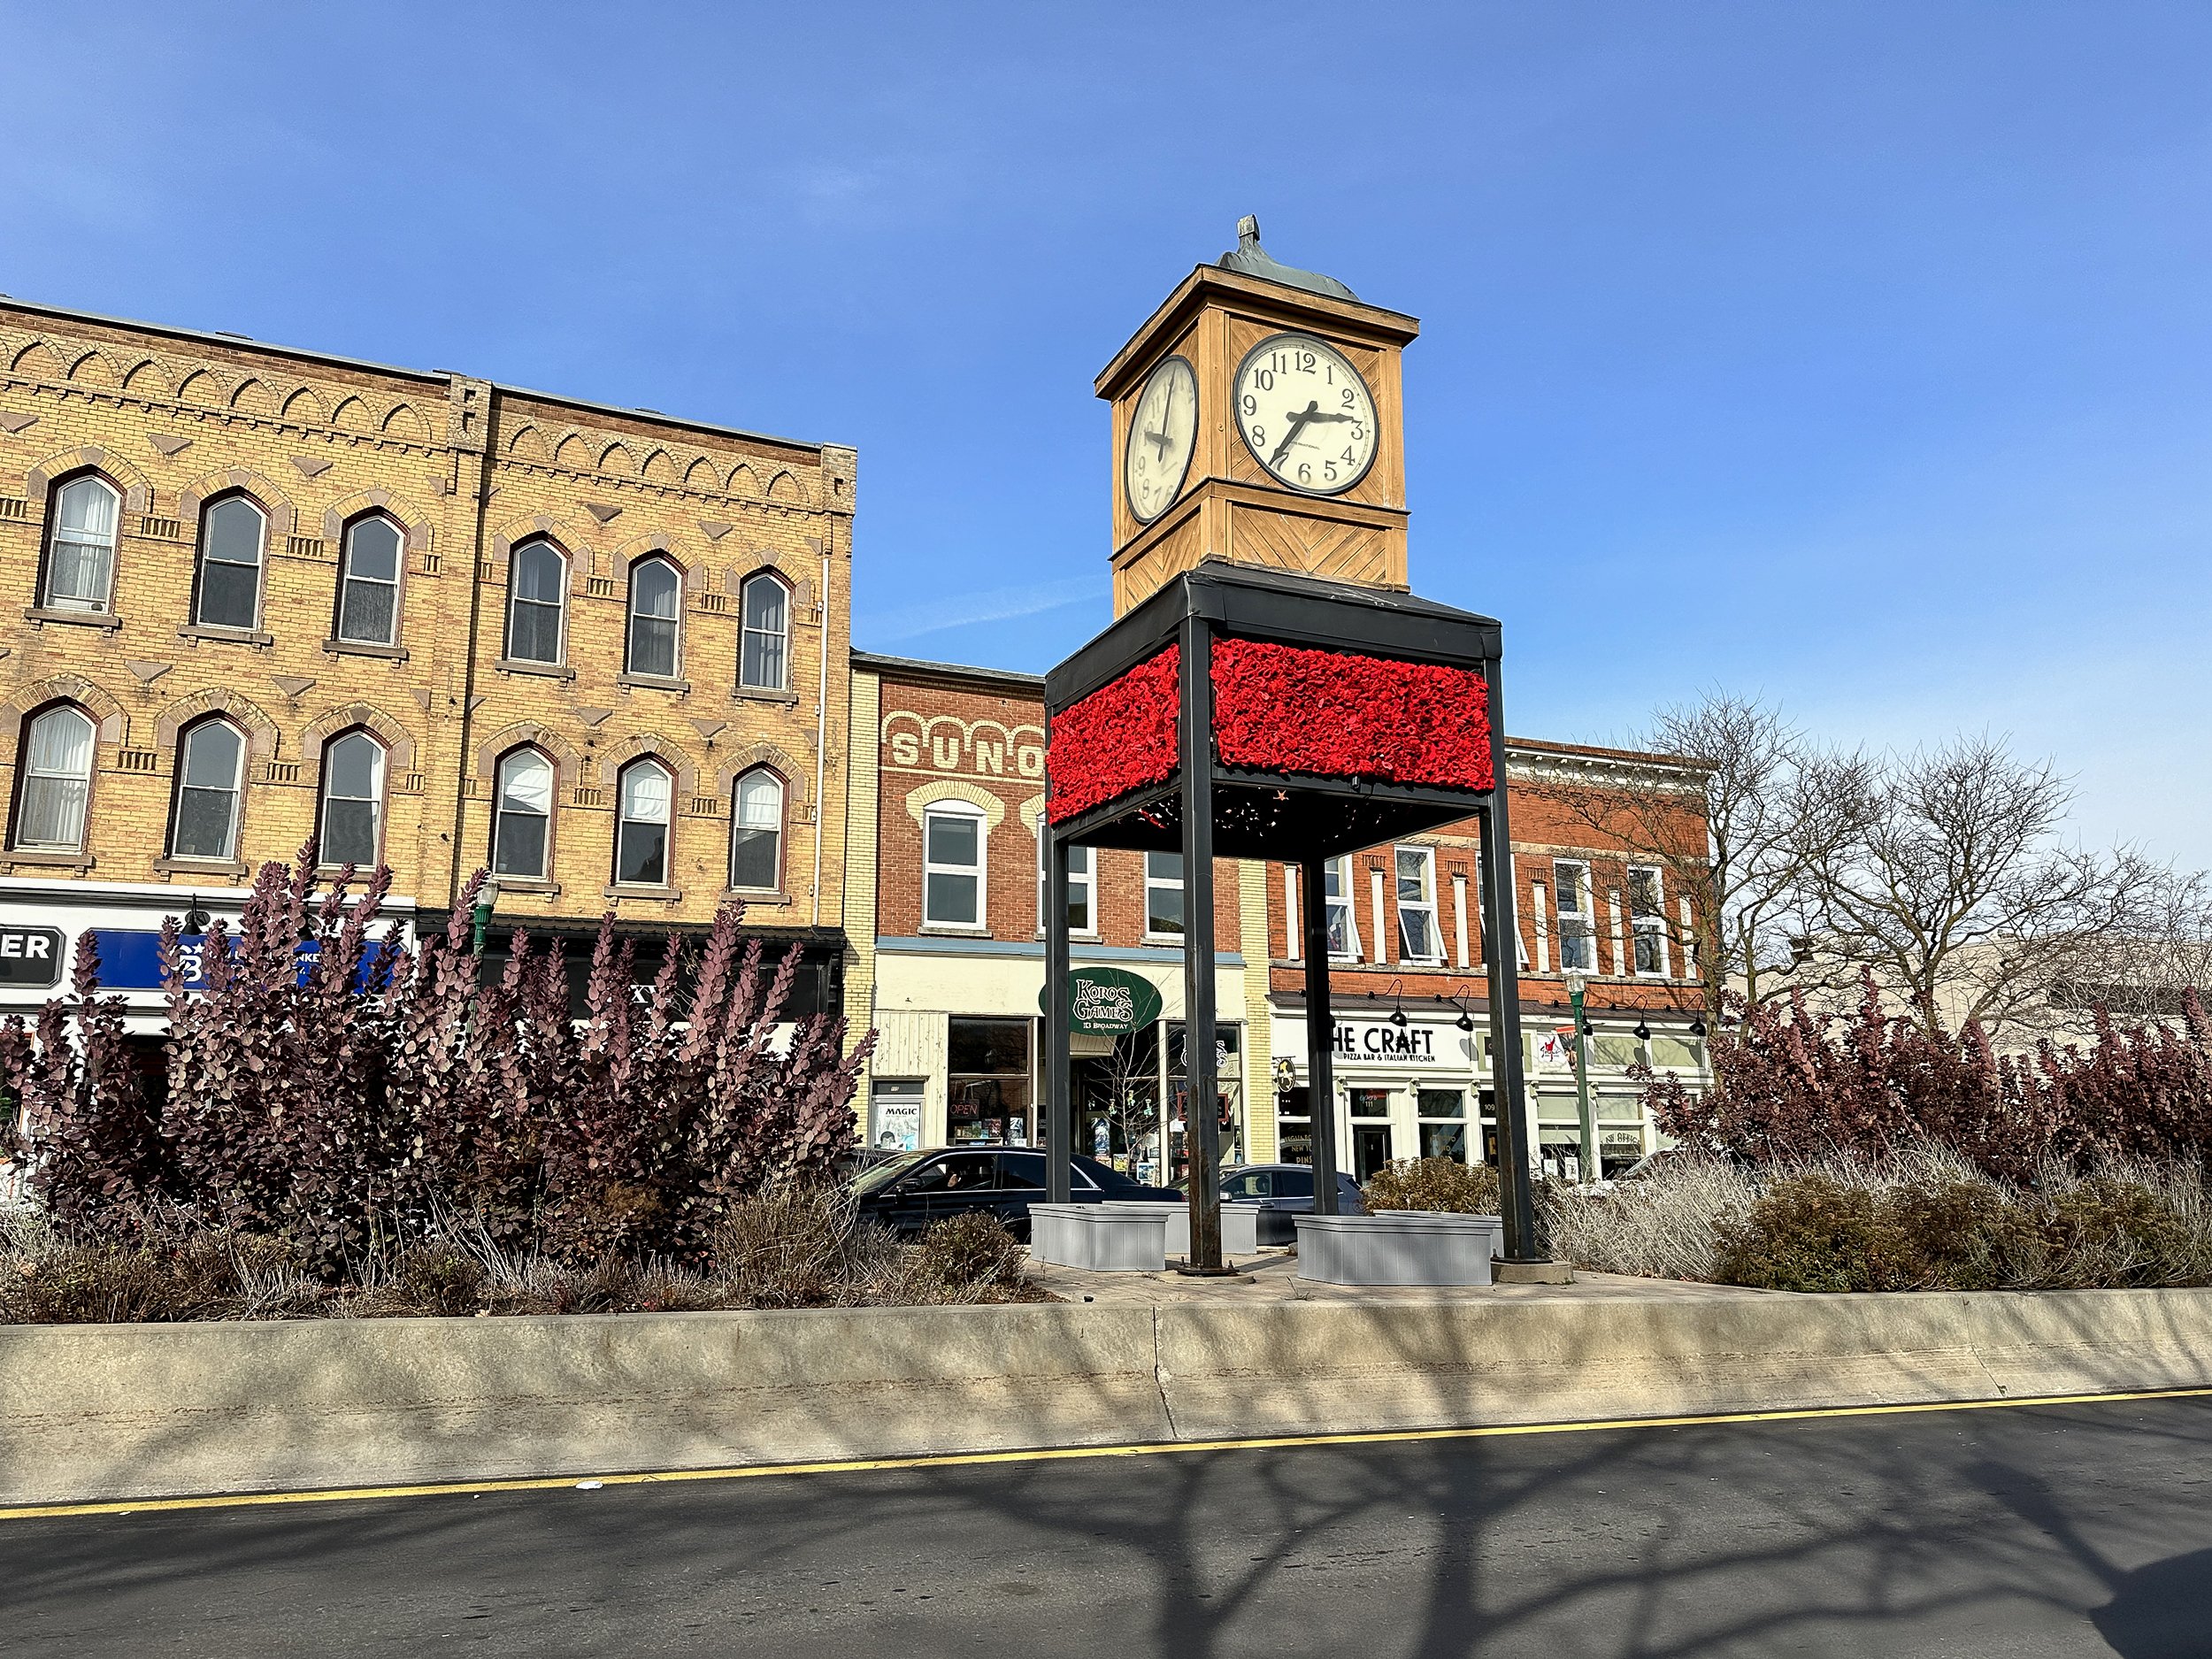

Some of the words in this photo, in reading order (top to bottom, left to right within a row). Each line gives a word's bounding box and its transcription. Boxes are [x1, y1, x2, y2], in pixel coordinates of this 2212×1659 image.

[1271, 351, 1287, 375] 11
[1295, 350, 1317, 375] 12
[1254, 367, 1274, 391] 10
[1326, 365, 1333, 386] 1
[1242, 395, 1257, 417] 9
[1340, 388, 1356, 411] 2
[1251, 425, 1266, 448] 8
[1350, 419, 1364, 441] 3
[1340, 445, 1356, 466] 4
[1138, 456, 1146, 478] 9
[1298, 463, 1312, 485] 6
[1324, 459, 1338, 481] 5
[1141, 478, 1150, 500] 8
[1153, 486, 1164, 511] 7
[1072, 999, 1133, 1022] GAMES
[1332, 1026, 1356, 1052] HE
[1363, 1027, 1433, 1055] CRAFT
[949, 1103, 978, 1116] OPEN
